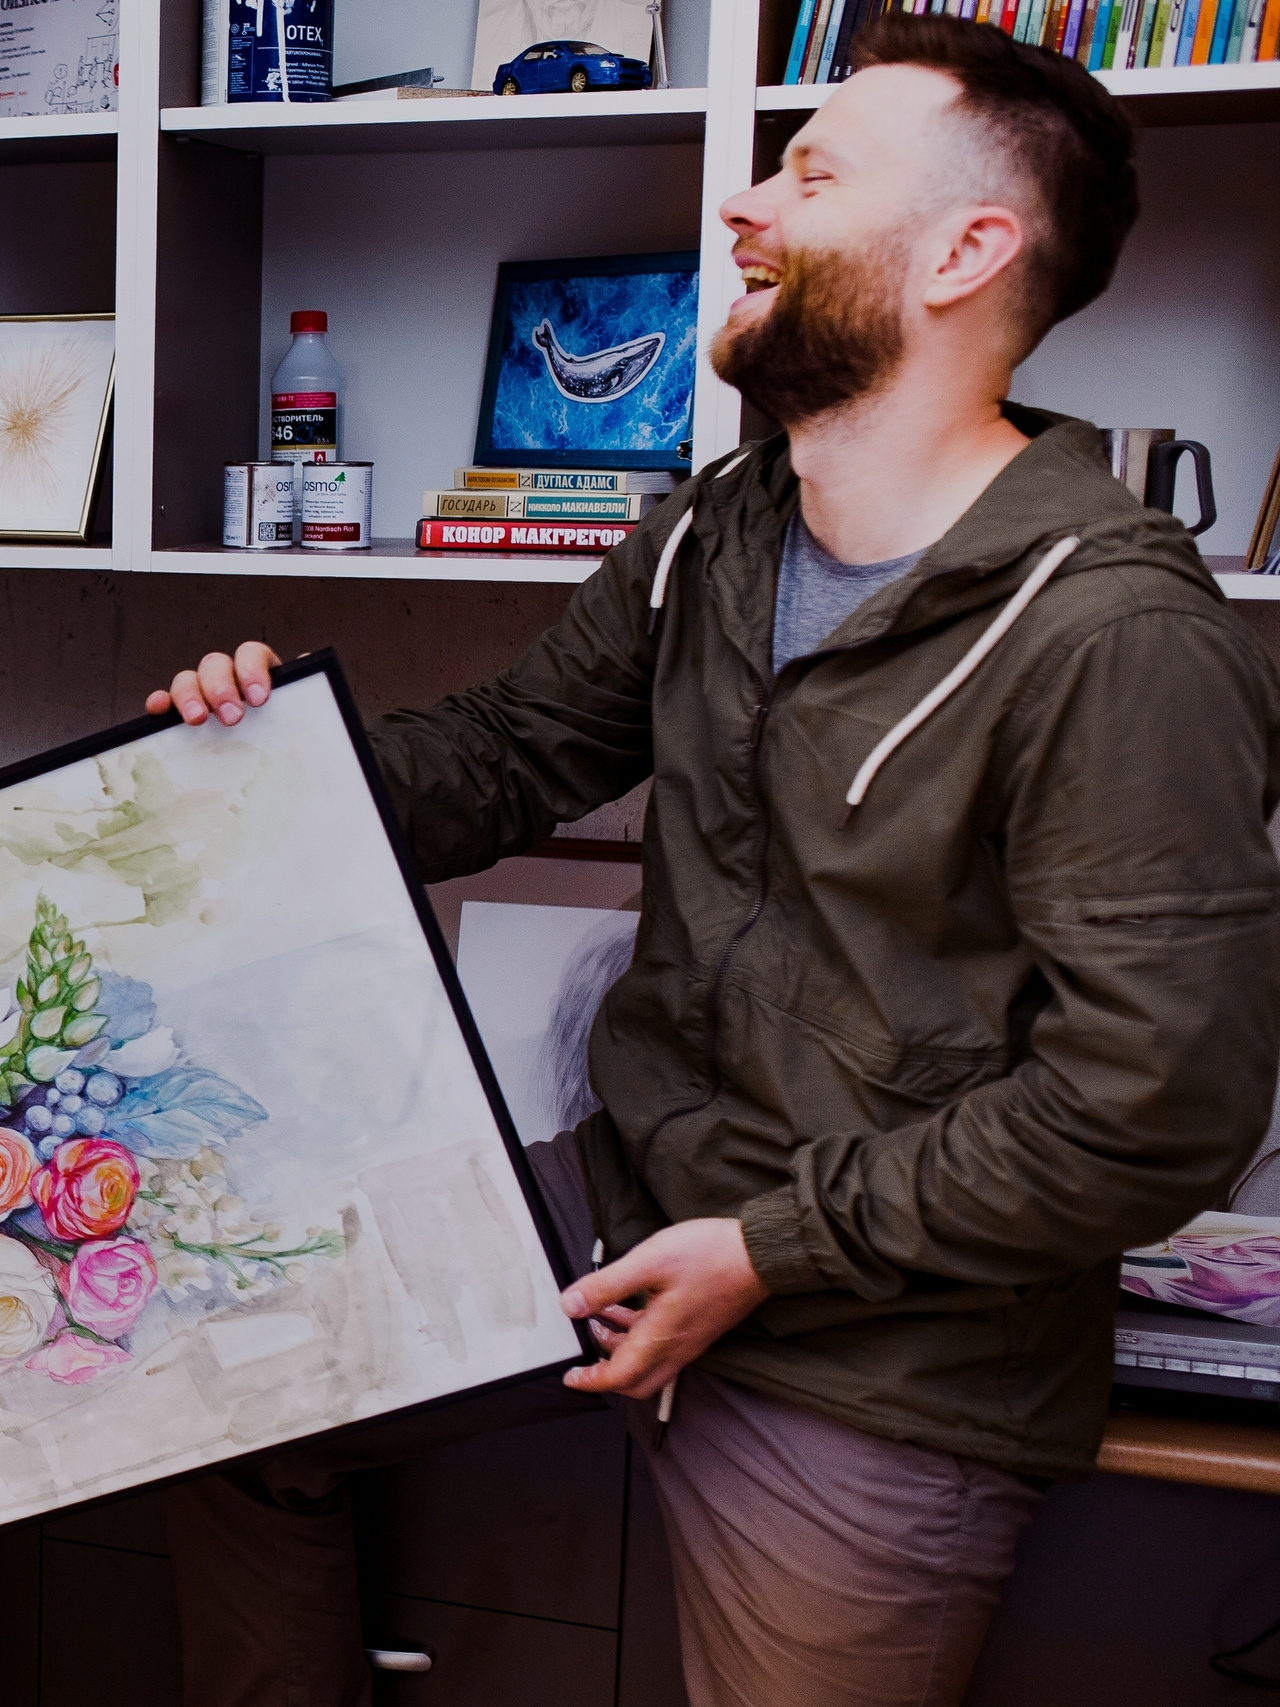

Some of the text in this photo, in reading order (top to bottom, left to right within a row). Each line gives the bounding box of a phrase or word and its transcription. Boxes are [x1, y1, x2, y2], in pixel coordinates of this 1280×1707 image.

[276, 481, 293, 491] osm
[305, 481, 337, 492] osmo
[536, 475, 613, 490] ДУГЛАС АДАМС
[441, 498, 496, 513] ГОСУДАРЬ
[528, 502, 625, 513] НИККОЛО МАКИАВЕЛЛИ
[442, 525, 626, 546] КОНОР МАКГРЕГОР
